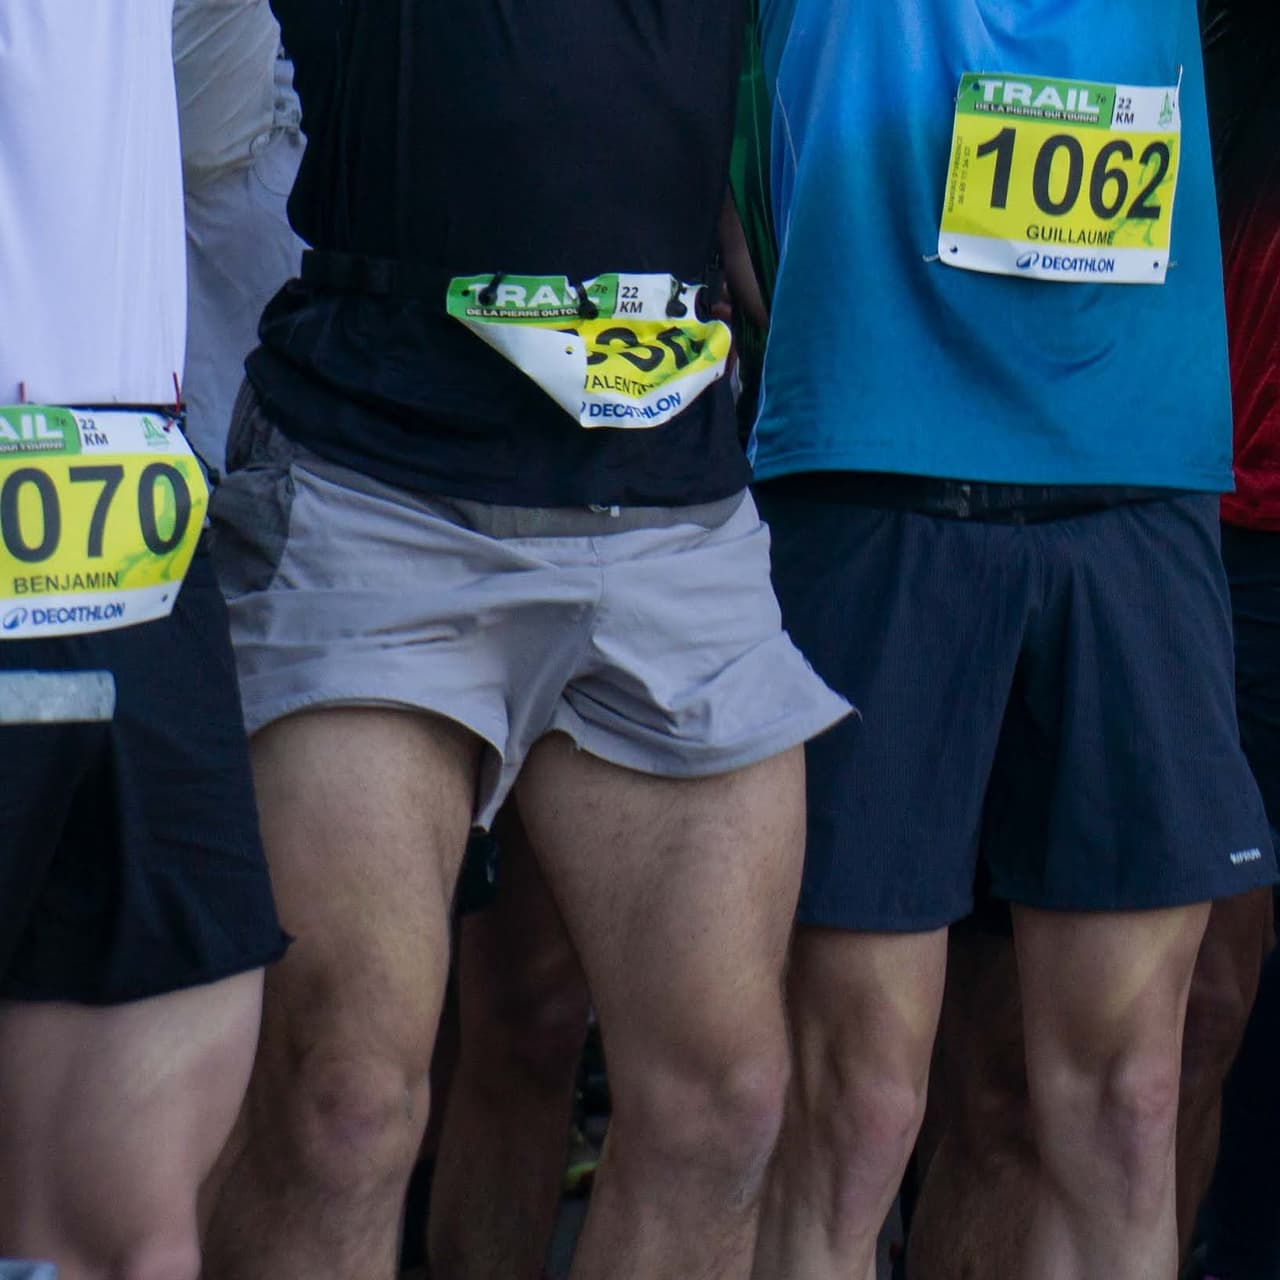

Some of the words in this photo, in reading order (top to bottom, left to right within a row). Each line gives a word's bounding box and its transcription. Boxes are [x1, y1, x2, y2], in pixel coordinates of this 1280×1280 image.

[978, 79, 1099, 112] TRAIL
[1117, 98, 1132, 111] 22
[1116, 113, 1135, 124] KM
[976, 126, 1170, 220] 1062
[1026, 224, 1115, 246] GUILLAUME
[1042, 254, 1115, 272] DECATHLON
[621, 286, 638, 299] 22
[619, 300, 643, 313] KM
[589, 392, 681, 418] DECATHLON
[0, 414, 63, 441] AIL
[81, 418, 96, 430] 22
[84, 432, 109, 446] KM
[0, 461, 191, 563] 070
[13, 571, 119, 595] BENJAMIN
[32, 602, 125, 625] DECATHLON
